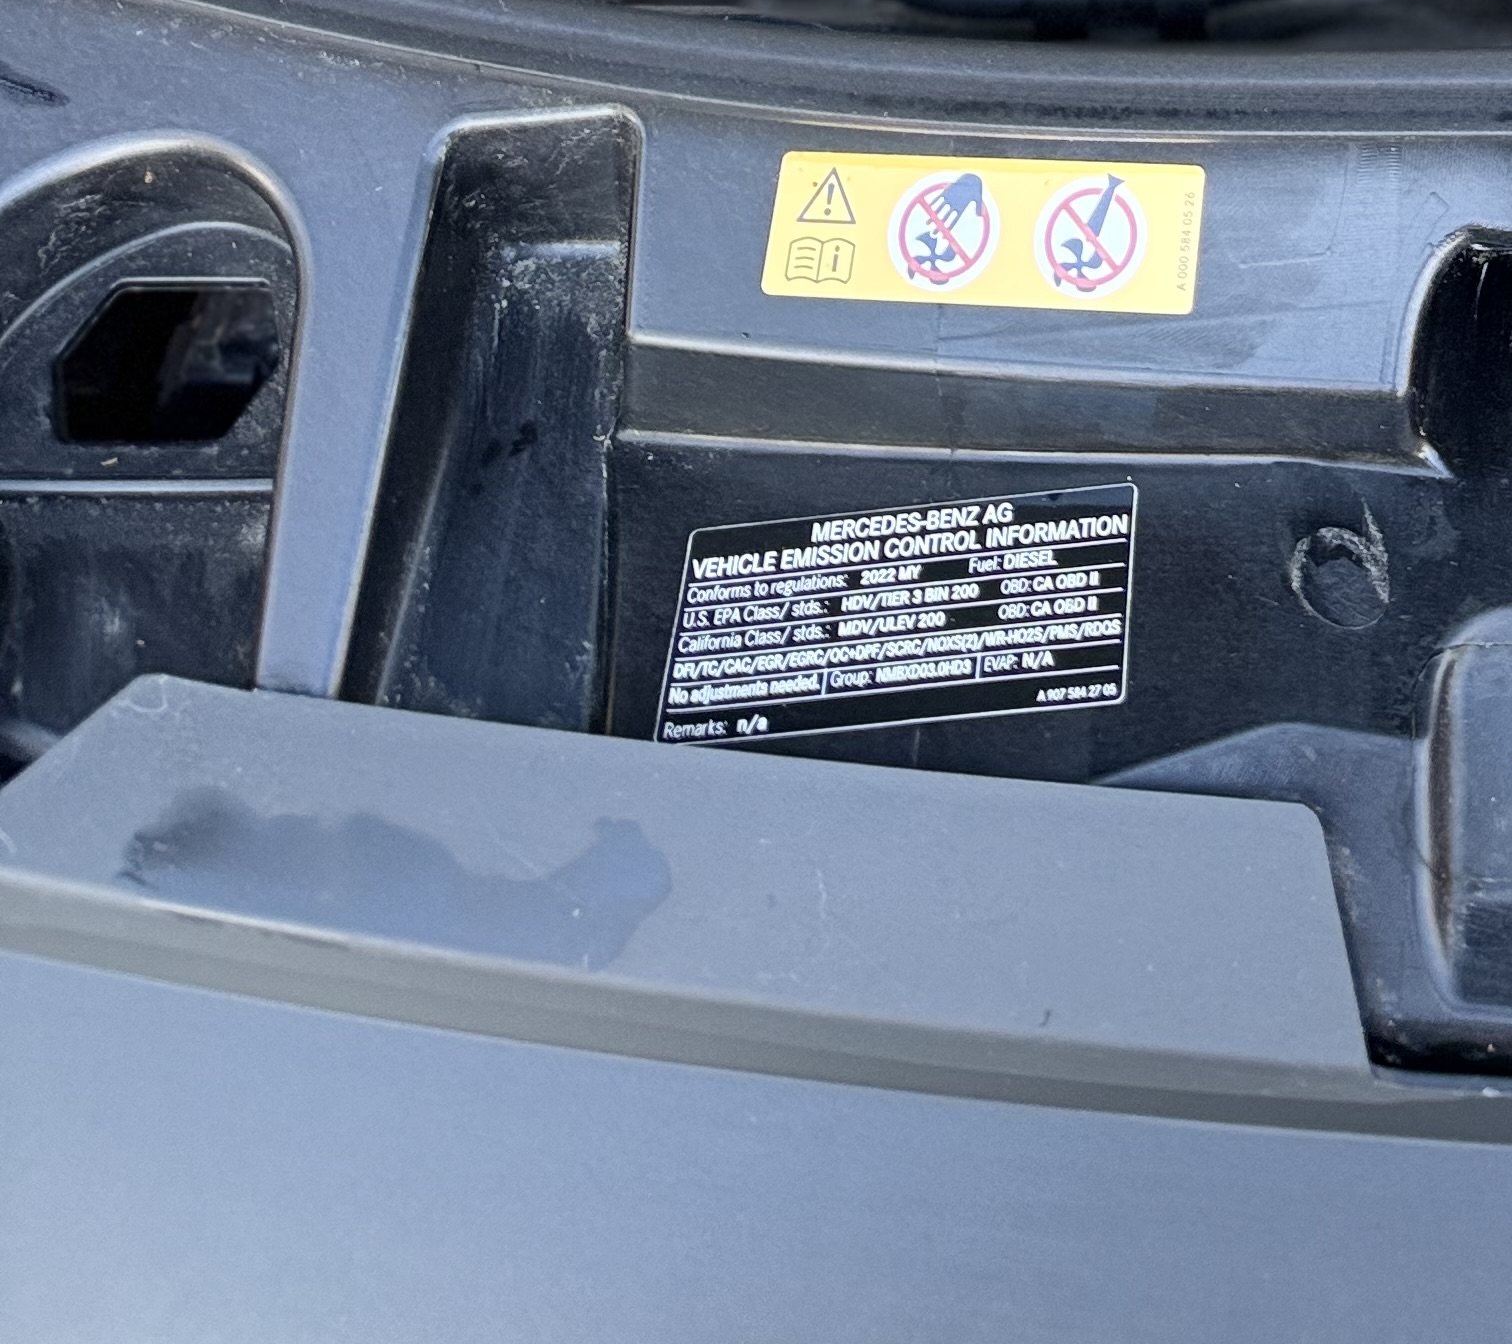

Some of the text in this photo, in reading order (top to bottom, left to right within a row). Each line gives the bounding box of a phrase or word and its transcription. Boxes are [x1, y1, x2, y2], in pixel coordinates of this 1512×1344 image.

[1176, 191, 1195, 292] A 000 584 05 26
[692, 514, 1129, 580] VEHICLE EMISSION CONTROL INFORMATION
[811, 502, 1014, 543] MERCEDES-BENZ AG
[682, 611, 710, 629] U.S.
[713, 607, 742, 626] EPA
[743, 601, 790, 623] Class/
[840, 589, 911, 613] HDV/TIER
[911, 588, 923, 605] 3
[924, 585, 950, 603] BIN
[950, 583, 980, 601] 200
[1000, 578, 1032, 595] OBD:
[1032, 575, 1054, 593] CA
[1055, 572, 1088, 589] OBD
[687, 550, 1058, 604] Conforms to regulations: 2022 MY Fuel: DIESEL
[678, 631, 742, 654] California
[744, 625, 791, 647] Class/
[838, 613, 917, 637] MDV/ULEV
[917, 611, 946, 629] 200
[998, 603, 1031, 620] OBD:
[1030, 600, 1053, 618] CA
[1053, 597, 1086, 615] OBD
[668, 687, 689, 705] No
[689, 680, 768, 705] adjustments
[769, 673, 821, 695] needed.
[830, 670, 873, 688] Group:
[983, 656, 1019, 674] EVAP:
[1021, 650, 1055, 670] N/A
[1036, 688, 1046, 703] A
[1087, 683, 1102, 699] 27
[662, 713, 769, 740] Remarks: n/a
